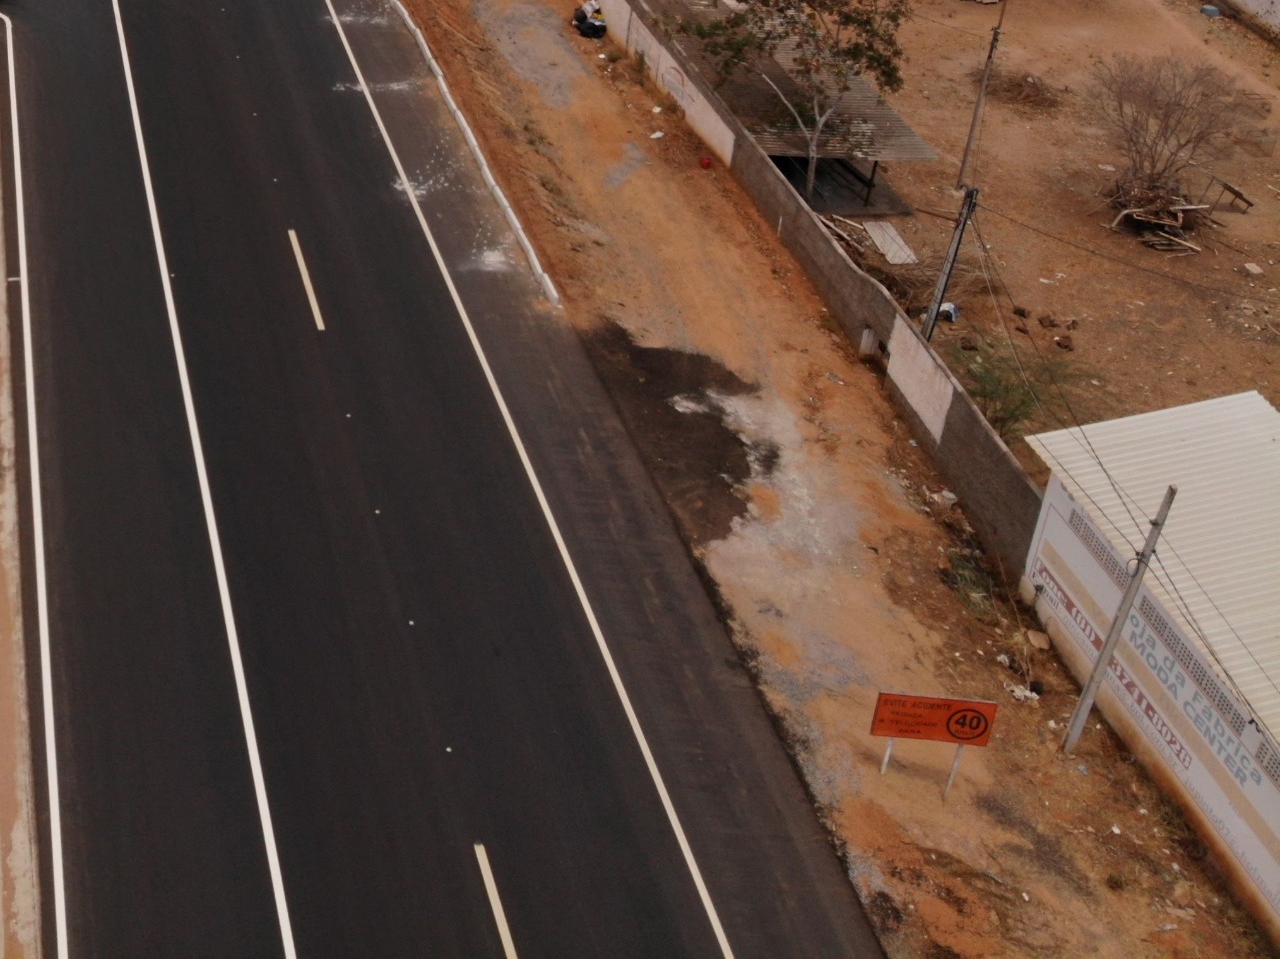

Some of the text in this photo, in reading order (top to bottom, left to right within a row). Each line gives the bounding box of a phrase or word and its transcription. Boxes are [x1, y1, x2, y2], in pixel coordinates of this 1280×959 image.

[883, 699, 953, 711] EVITE ACIDENTE
[955, 713, 982, 730] 40
[1110, 657, 1191, 769] 3741-8028
[1128, 613, 1157, 650] oja
[1163, 655, 1186, 689] da
[1191, 690, 1262, 786] Fábrica
[1129, 630, 1248, 787] MODA CENTER
